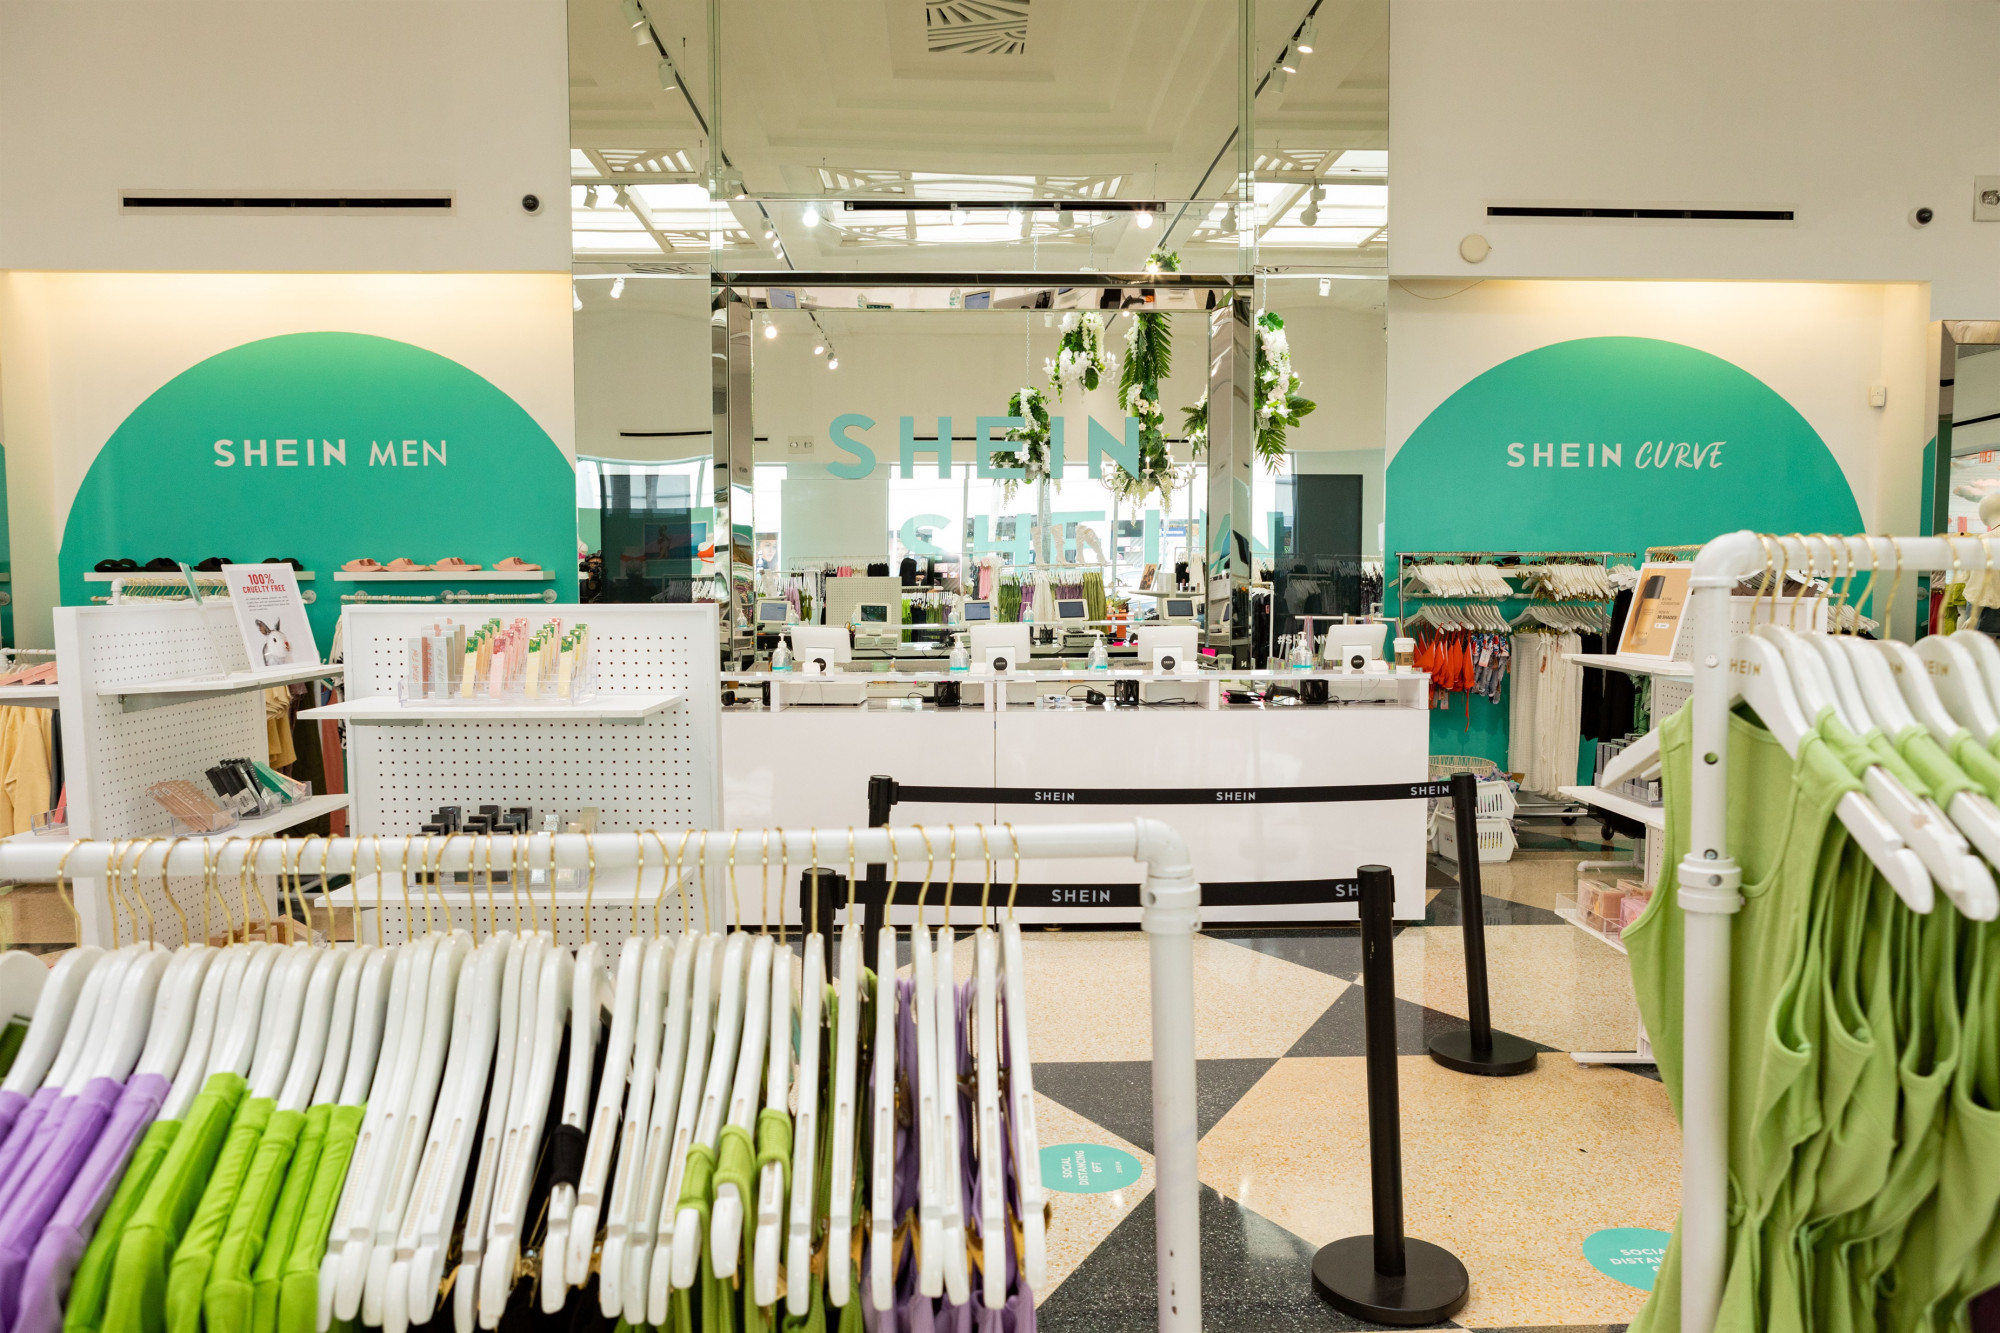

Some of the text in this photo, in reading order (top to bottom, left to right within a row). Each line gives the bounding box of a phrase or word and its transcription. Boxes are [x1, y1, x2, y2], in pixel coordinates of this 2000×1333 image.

[213, 439, 447, 468] SHEIN MEN
[825, 413, 1140, 481] SHEIN
[1506, 440, 1727, 470] SHEIN CURVE
[248, 573, 275, 585] 100%
[242, 584, 286, 594] CRUELTY FREE
[1728, 658, 1761, 676] HEIN
[1924, 660, 1949, 676] EIN
[1034, 791, 1075, 801] SHEIN
[1216, 791, 1256, 801] SHEIN
[1410, 784, 1450, 796] SHEIN
[1051, 889, 1110, 902] SHEIN
[1061, 1157, 1073, 1179] SOCIAL
[1075, 1150, 1089, 1186] DISTANCING
[1091, 1161, 1103, 1173] 6FT
[1620, 1248, 1666, 1256] SOCIA
